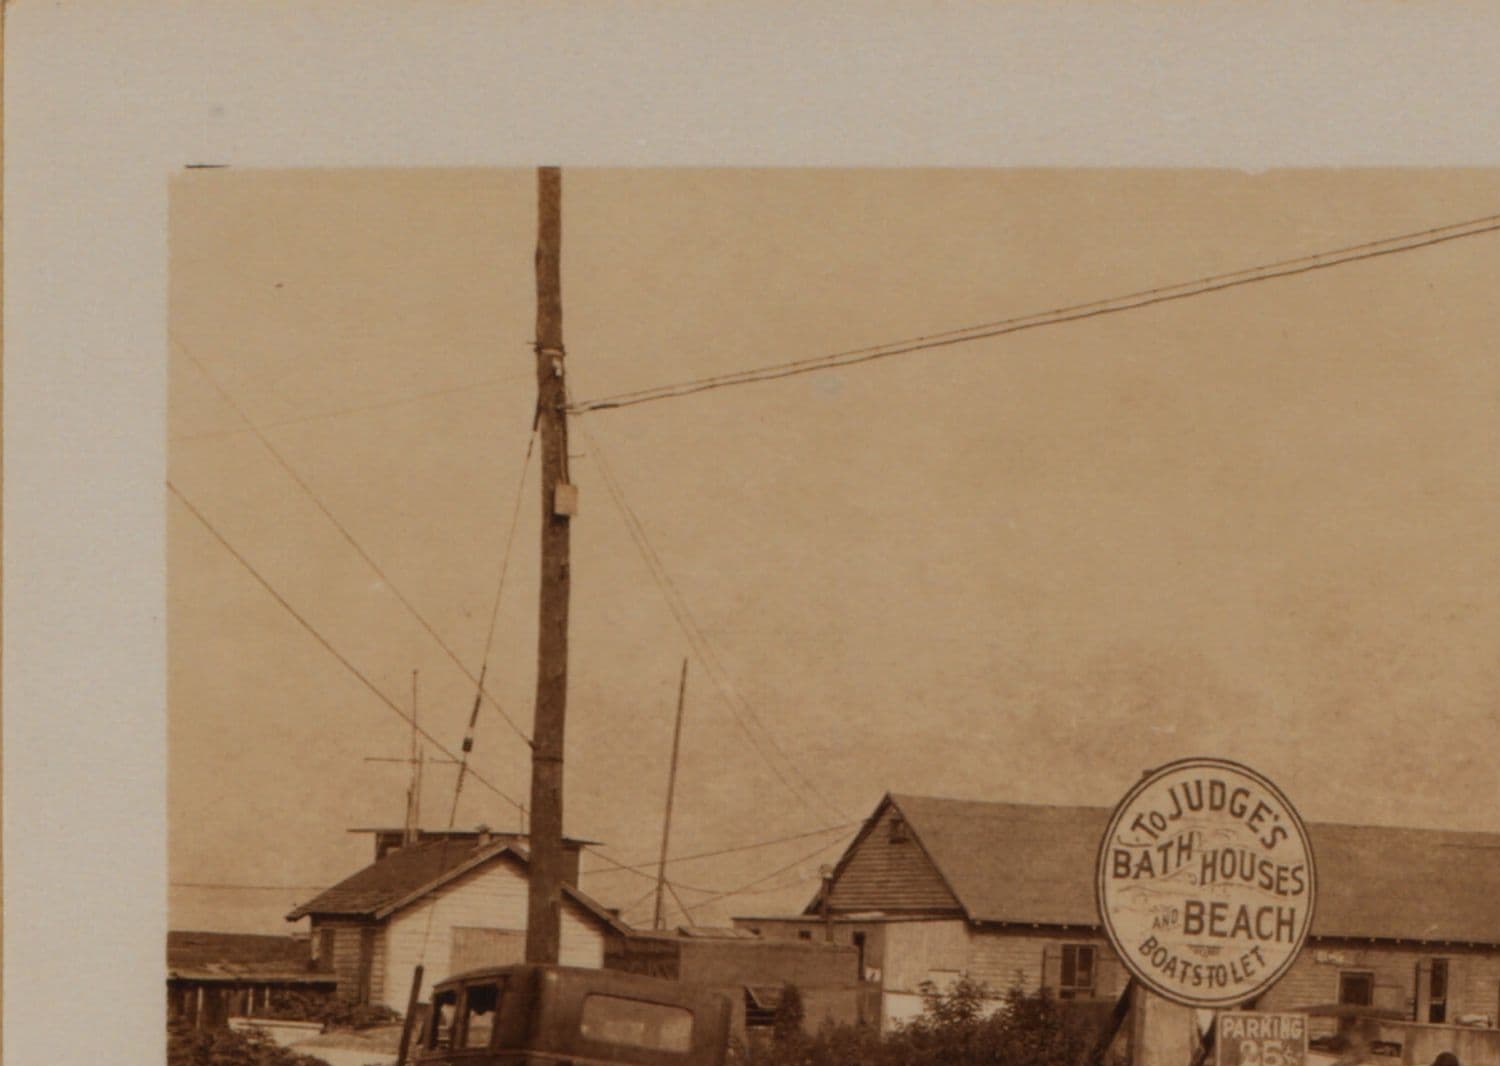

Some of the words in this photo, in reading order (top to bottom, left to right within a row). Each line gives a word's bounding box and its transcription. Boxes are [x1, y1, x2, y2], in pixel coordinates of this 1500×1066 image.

[1168, 779, 1288, 850] JUDGE'S
[1112, 831, 1195, 880] BATH
[1200, 848, 1305, 897] HOUSES
[1153, 908, 1180, 930] AND
[1183, 900, 1296, 944] BEACH
[1138, 935, 1203, 988] BOATS
[1206, 964, 1228, 988] TO
[1230, 945, 1266, 984] LET
[1222, 1016, 1304, 1041] PARKING
